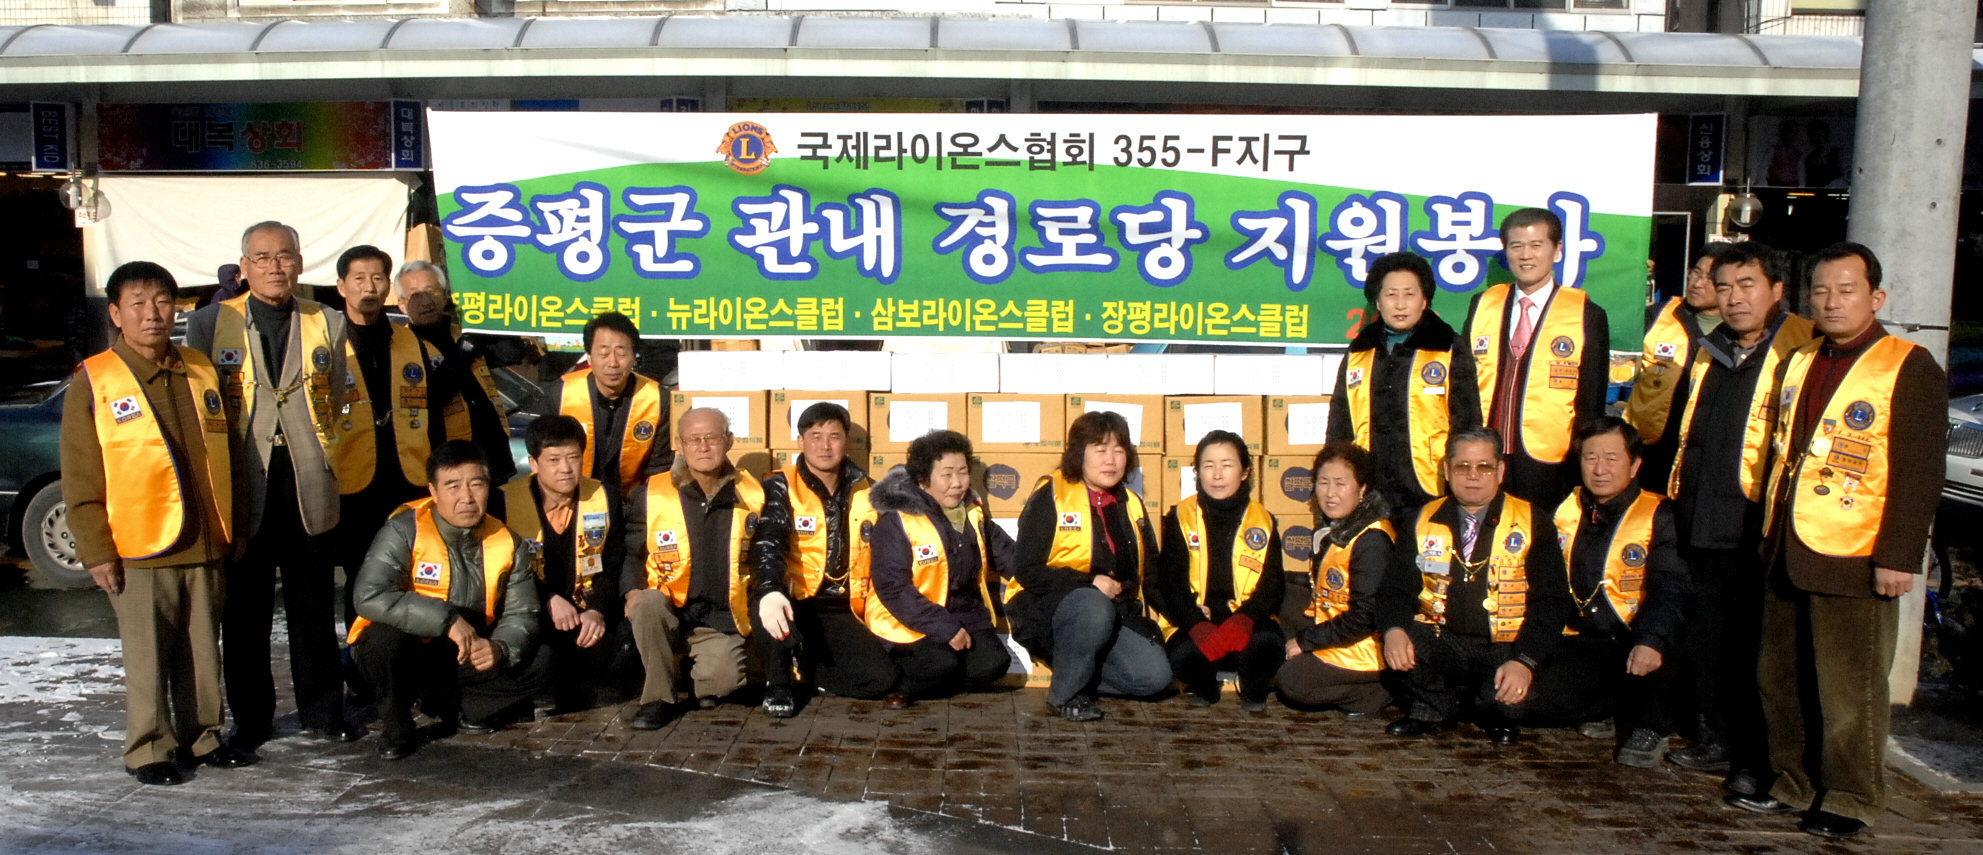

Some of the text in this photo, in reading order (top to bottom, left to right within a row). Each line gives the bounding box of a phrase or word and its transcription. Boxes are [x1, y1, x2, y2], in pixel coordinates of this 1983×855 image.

[41, 110, 60, 163] BEST KID
[732, 123, 764, 135] LIONS
[739, 138, 756, 160] L
[797, 131, 1310, 172] 국제라이온스협회 355-F지구
[444, 186, 706, 279] 증평군
[731, 187, 898, 281] 관내
[936, 193, 1206, 283] 경로당
[451, 291, 641, 330] 평라이온스클럽
[666, 297, 844, 332] 뉴라이온스클럽
[870, 298, 1075, 335] 삼보라이온스클럽
[1101, 300, 1309, 338] 장평라이온스클럽
